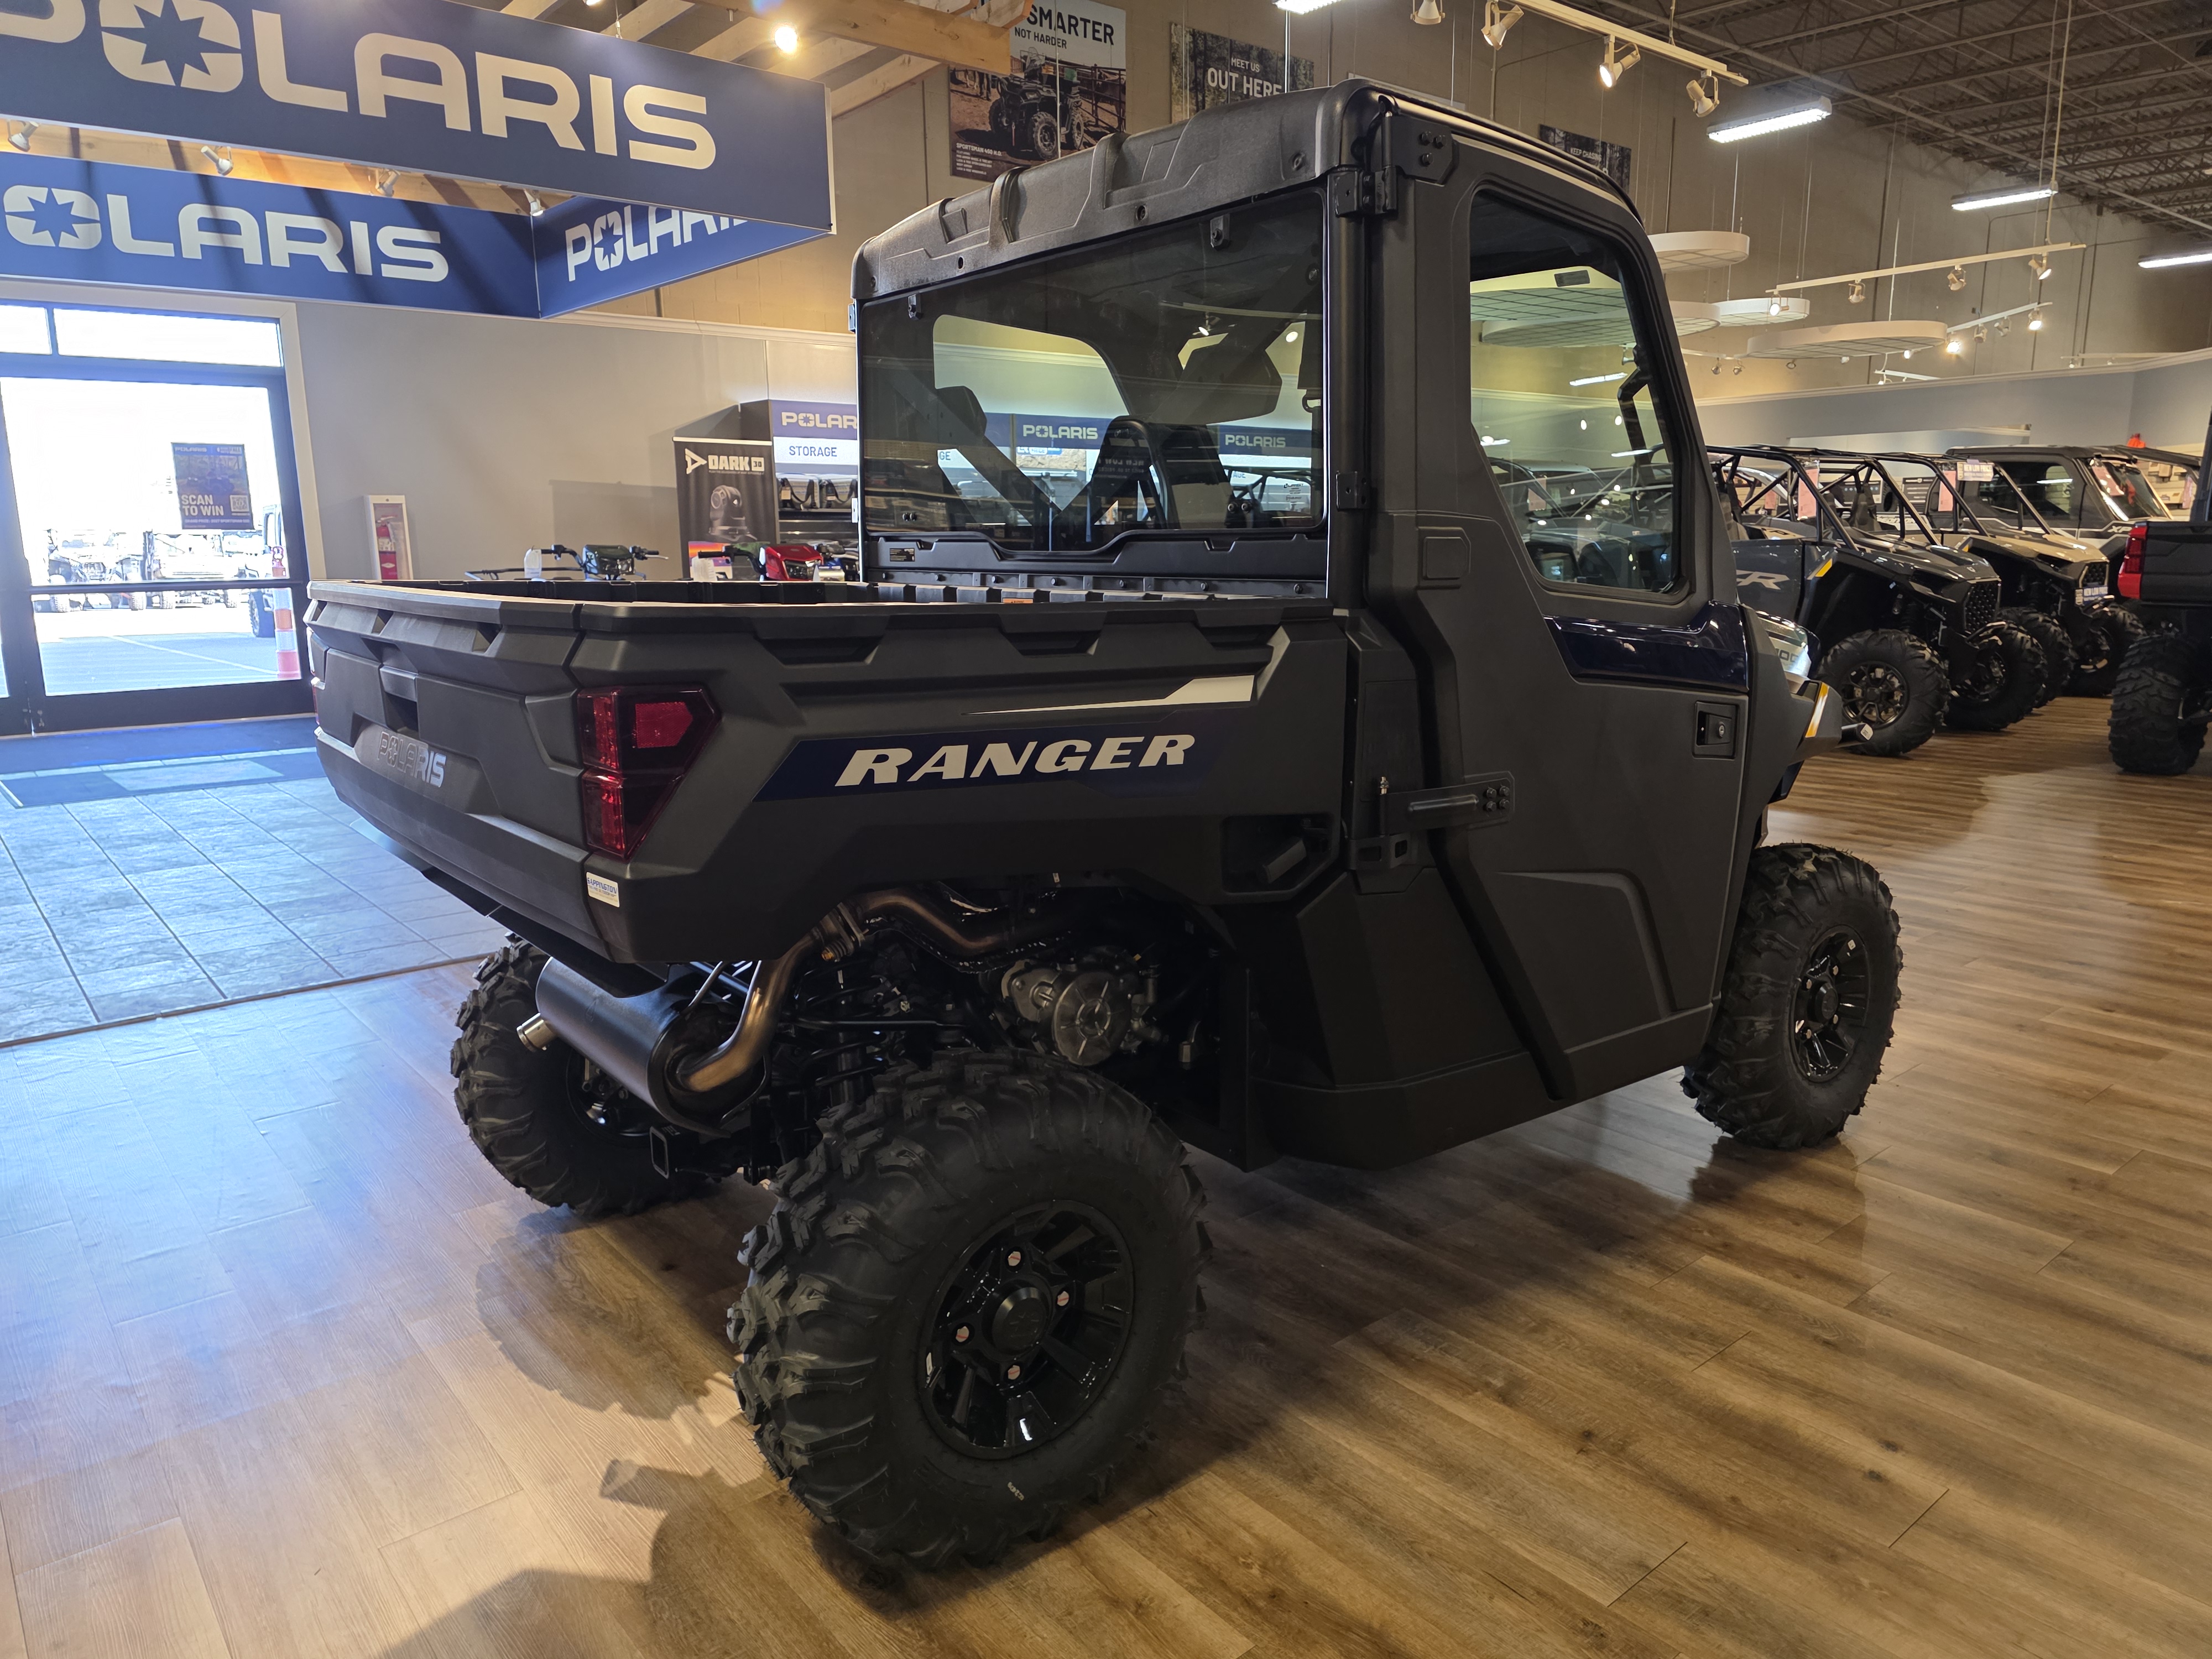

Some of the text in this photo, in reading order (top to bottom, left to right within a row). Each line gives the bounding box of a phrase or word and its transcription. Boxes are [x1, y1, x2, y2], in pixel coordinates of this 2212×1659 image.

[1027, 4, 1114, 45] SMARTER
[1015, 27, 1067, 49] NOT HARDER
[1231, 58, 1260, 72] MEET US
[0, 0, 716, 170] OLARIS
[1208, 67, 1282, 98] OUT HERE
[1571, 147, 1602, 161] KEEP CHASING
[3, 185, 449, 283] OLARIS
[781, 411, 857, 429] POLAR
[1023, 425, 1098, 440] POLARIS
[1225, 434, 1286, 448] POLARIS
[789, 446, 837, 457] STORAGE
[940, 451, 951, 460] GE
[708, 455, 750, 471] DARK
[181, 494, 213, 505] SCAN
[182, 505, 224, 515] TO WIN
[377, 731, 447, 788] POLARIS
[834, 734, 1195, 787] RANGER
[587, 877, 618, 894] SAPPINGTON
